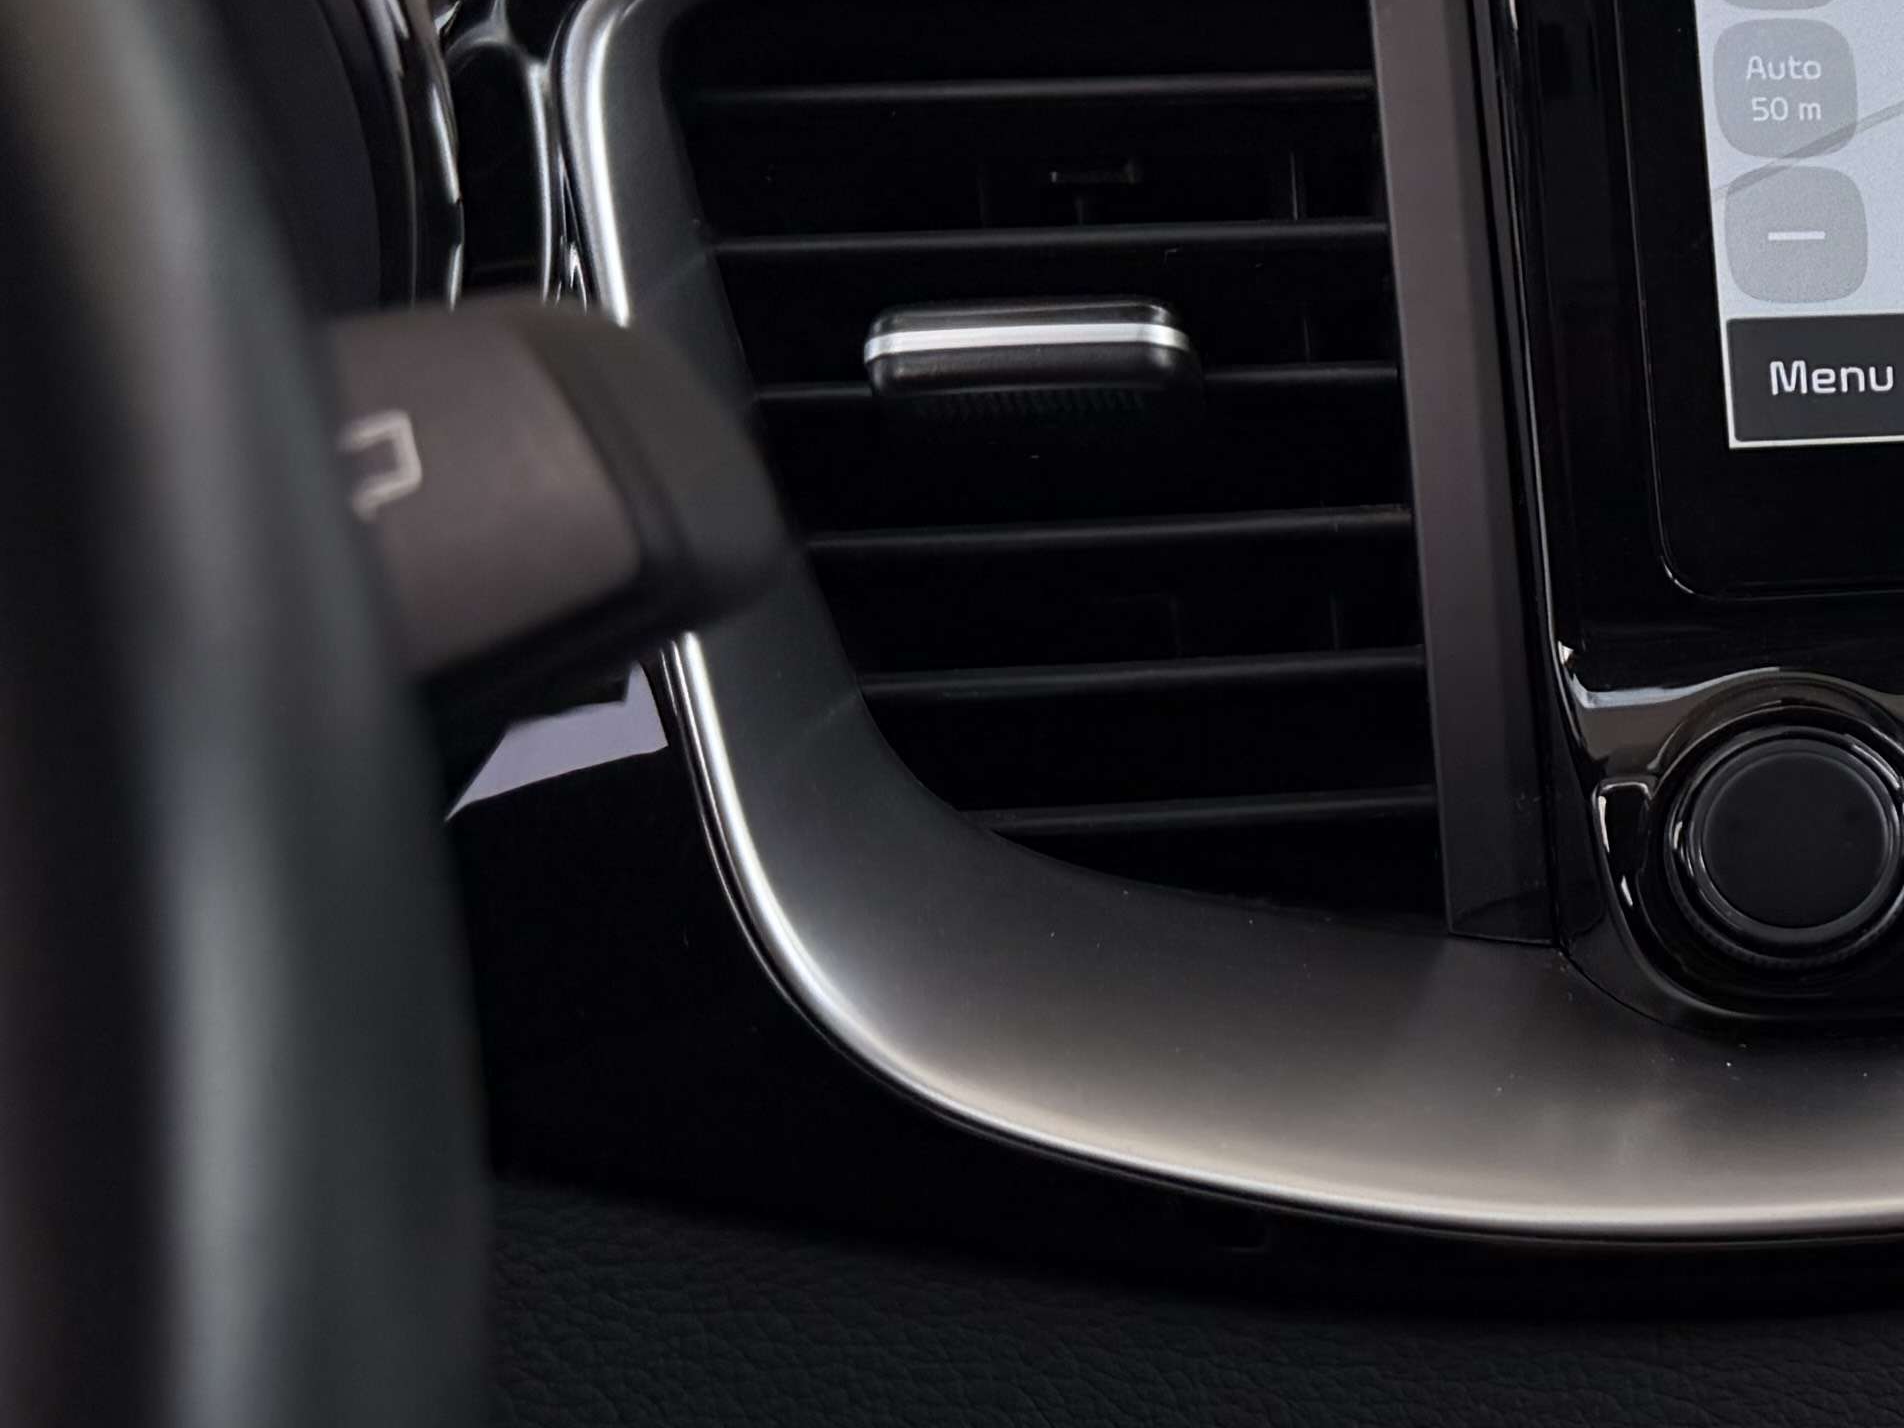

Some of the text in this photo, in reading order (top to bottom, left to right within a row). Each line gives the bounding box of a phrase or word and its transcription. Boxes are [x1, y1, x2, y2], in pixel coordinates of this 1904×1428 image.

[1745, 55, 1823, 81] Auto
[1751, 97, 1822, 122] 50 m
[1769, 359, 1895, 396] Menu
